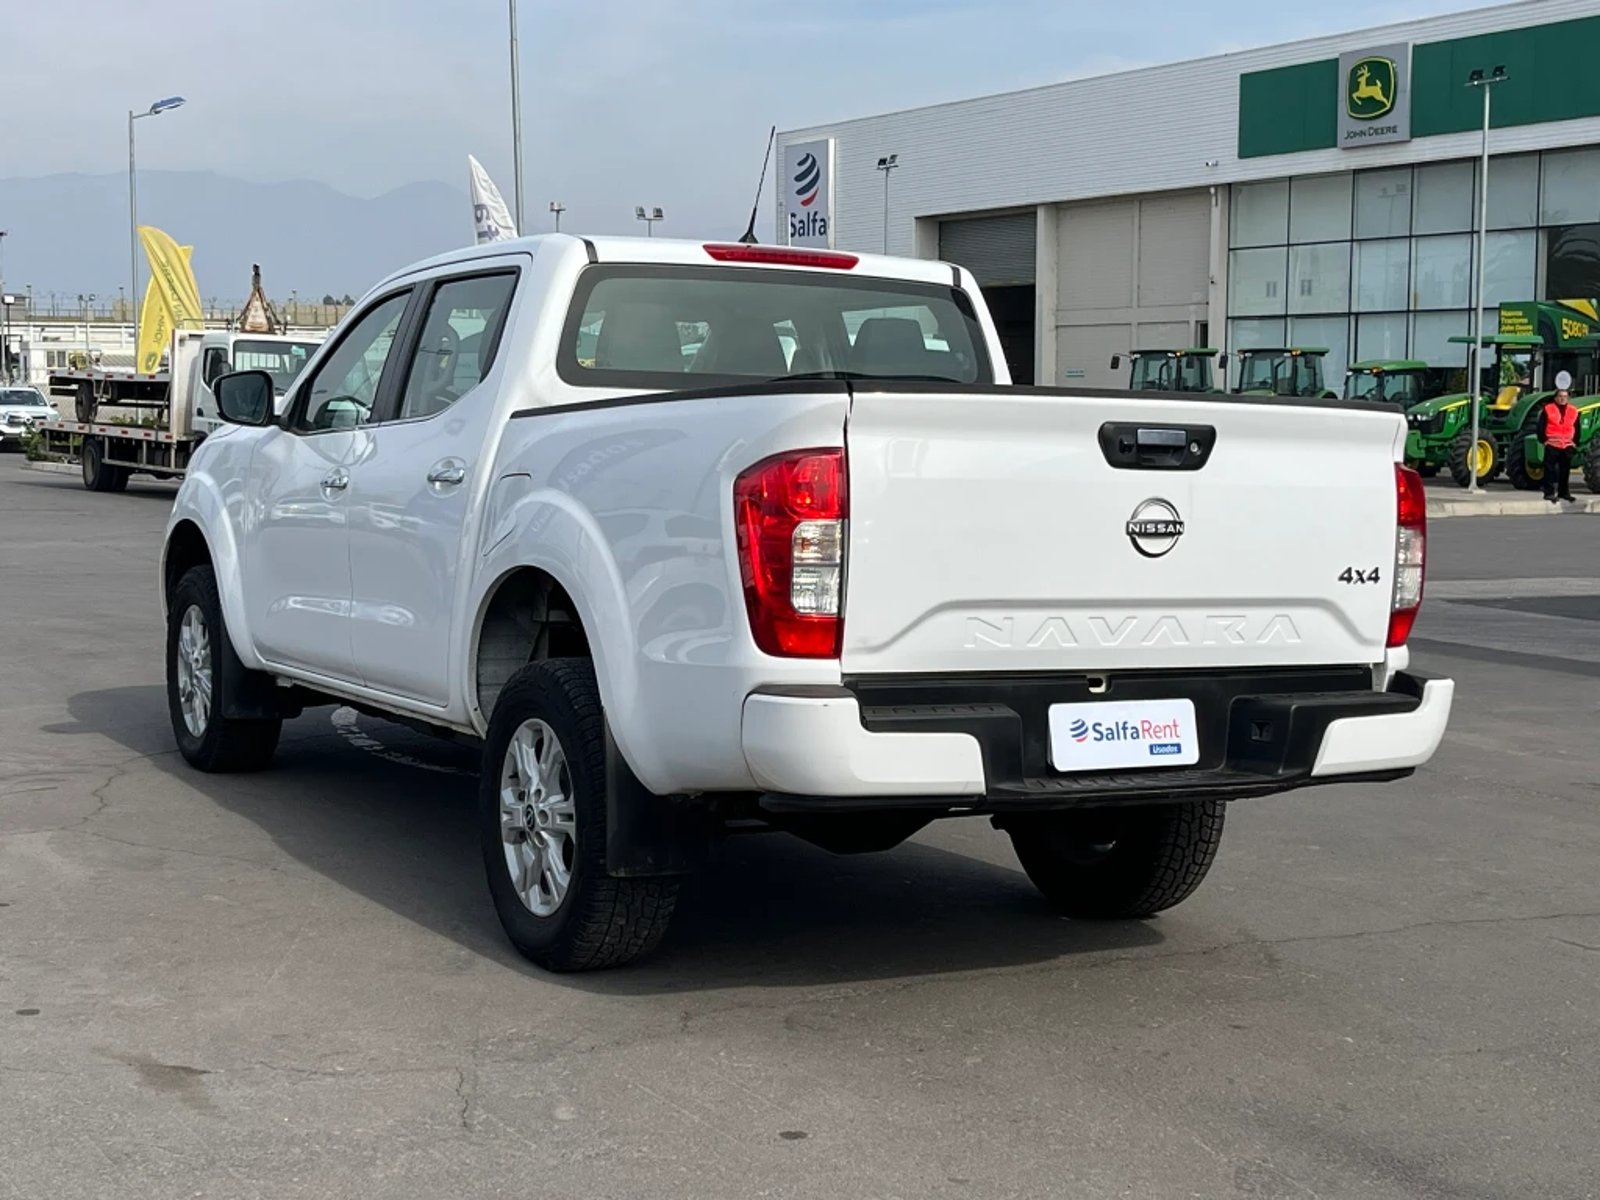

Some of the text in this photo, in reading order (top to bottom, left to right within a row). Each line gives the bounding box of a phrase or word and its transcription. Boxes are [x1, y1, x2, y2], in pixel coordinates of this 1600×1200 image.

[1344, 125, 1398, 140] JOHN DEERE
[790, 210, 827, 238] Salfa
[1128, 522, 1184, 534] NISSAN
[1337, 566, 1381, 585] 4x4
[963, 614, 1302, 647] NAVARA
[1092, 718, 1181, 742] SalfaRent
[1152, 744, 1179, 754] Usados
